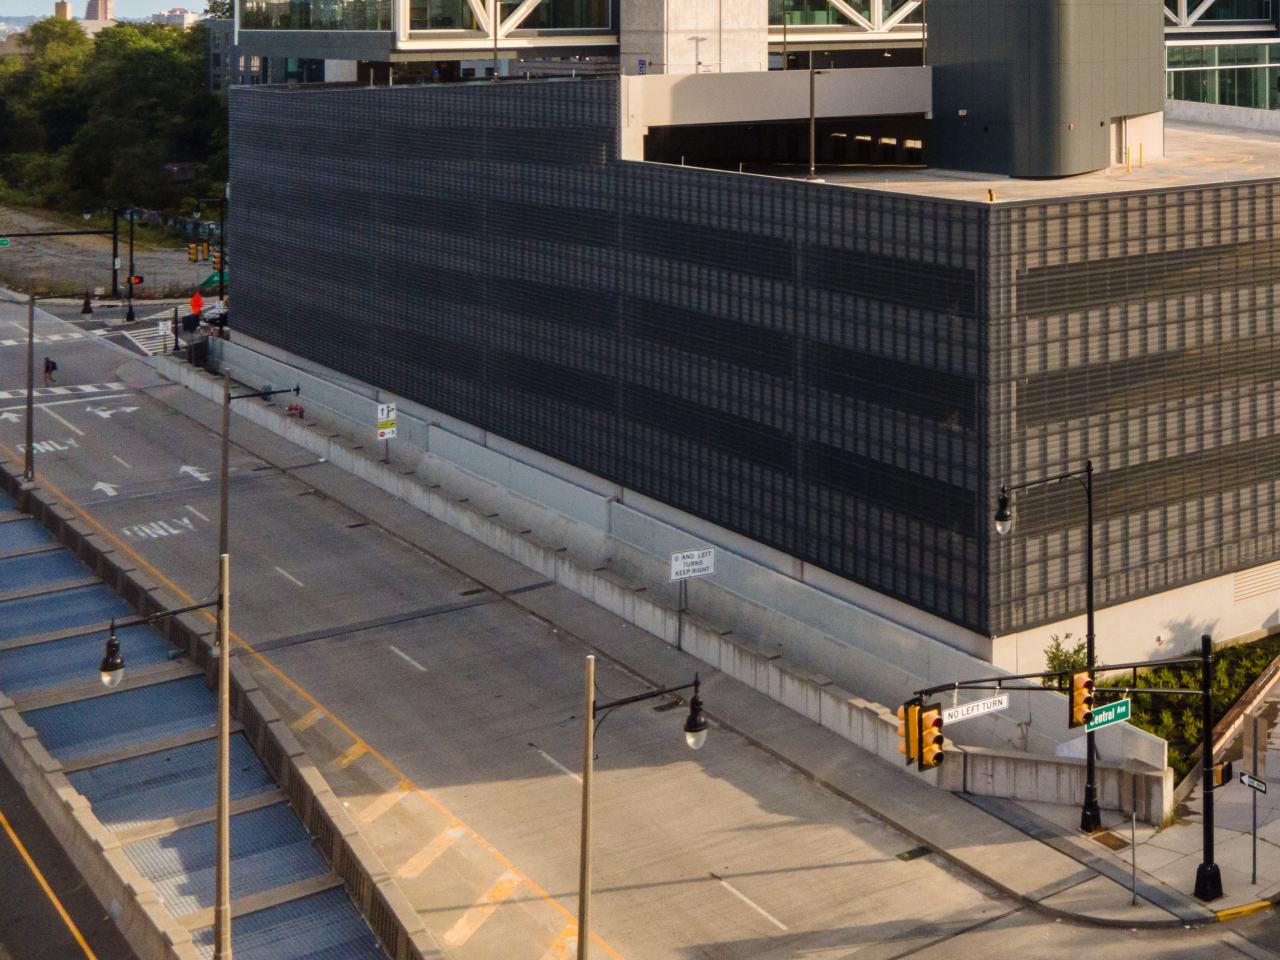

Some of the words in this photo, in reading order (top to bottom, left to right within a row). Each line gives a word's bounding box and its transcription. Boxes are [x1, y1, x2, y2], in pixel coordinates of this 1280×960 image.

[698, 551, 712, 559] LEFT
[683, 560, 703, 568] TURNS
[947, 710, 960, 721] NO
[961, 704, 980, 717] LEFT
[982, 698, 1004, 711] TURN
